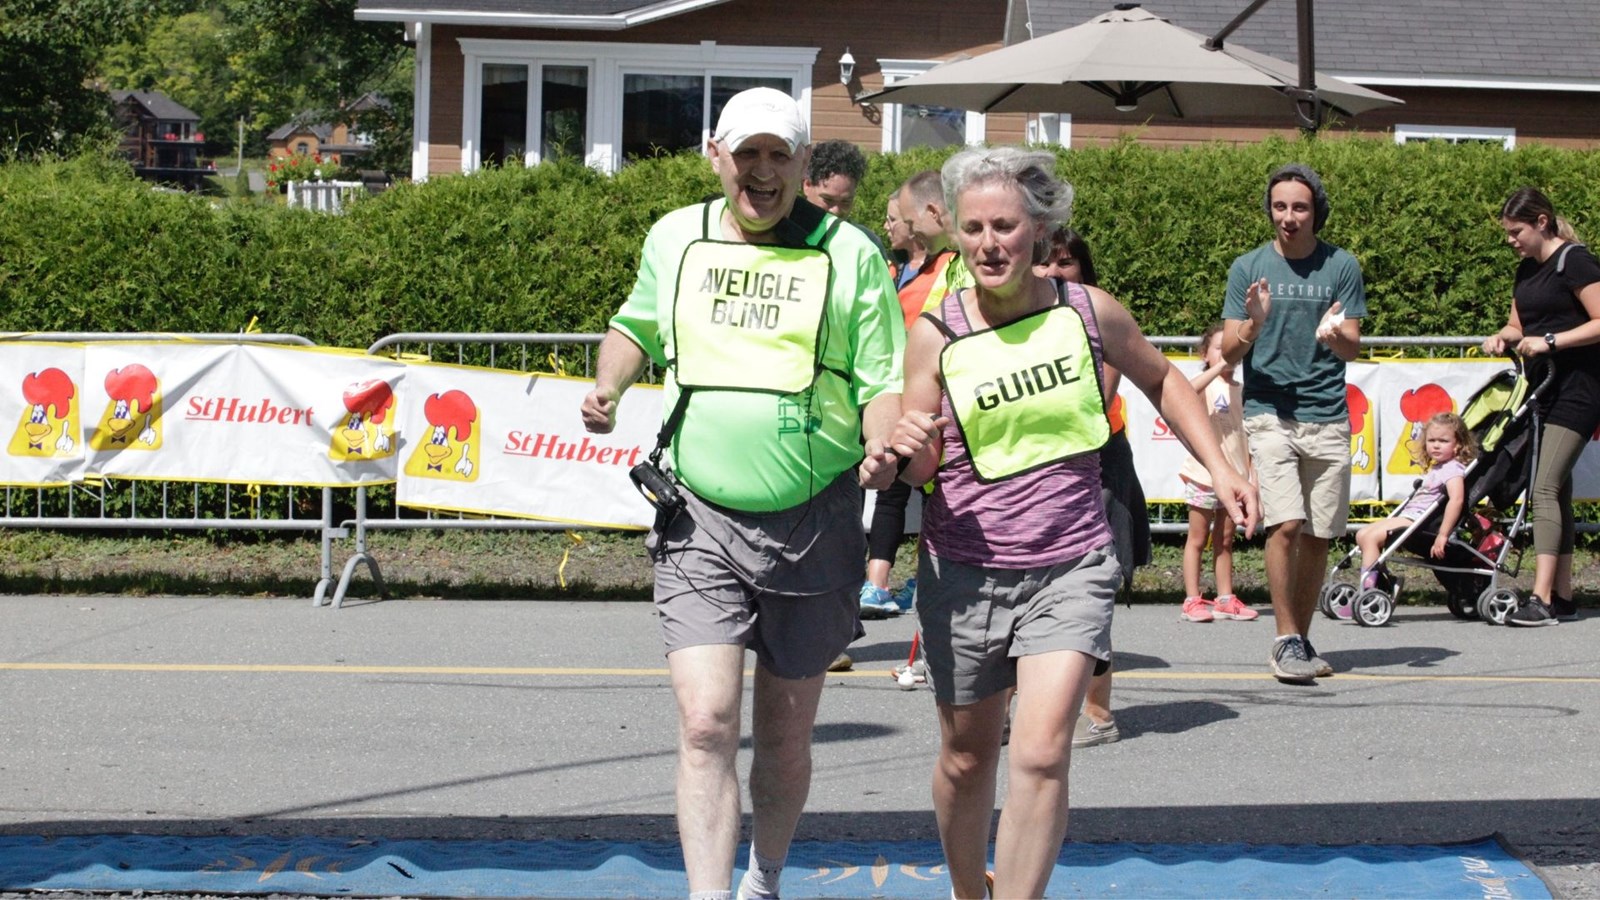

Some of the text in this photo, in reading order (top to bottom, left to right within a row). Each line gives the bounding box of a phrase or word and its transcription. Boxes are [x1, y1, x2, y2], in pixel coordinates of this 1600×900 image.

[699, 268, 805, 303] AVEUGLE
[1258, 283, 1332, 297] LECTRIC
[711, 298, 780, 330] BLIND
[974, 354, 1081, 411] GUIDE
